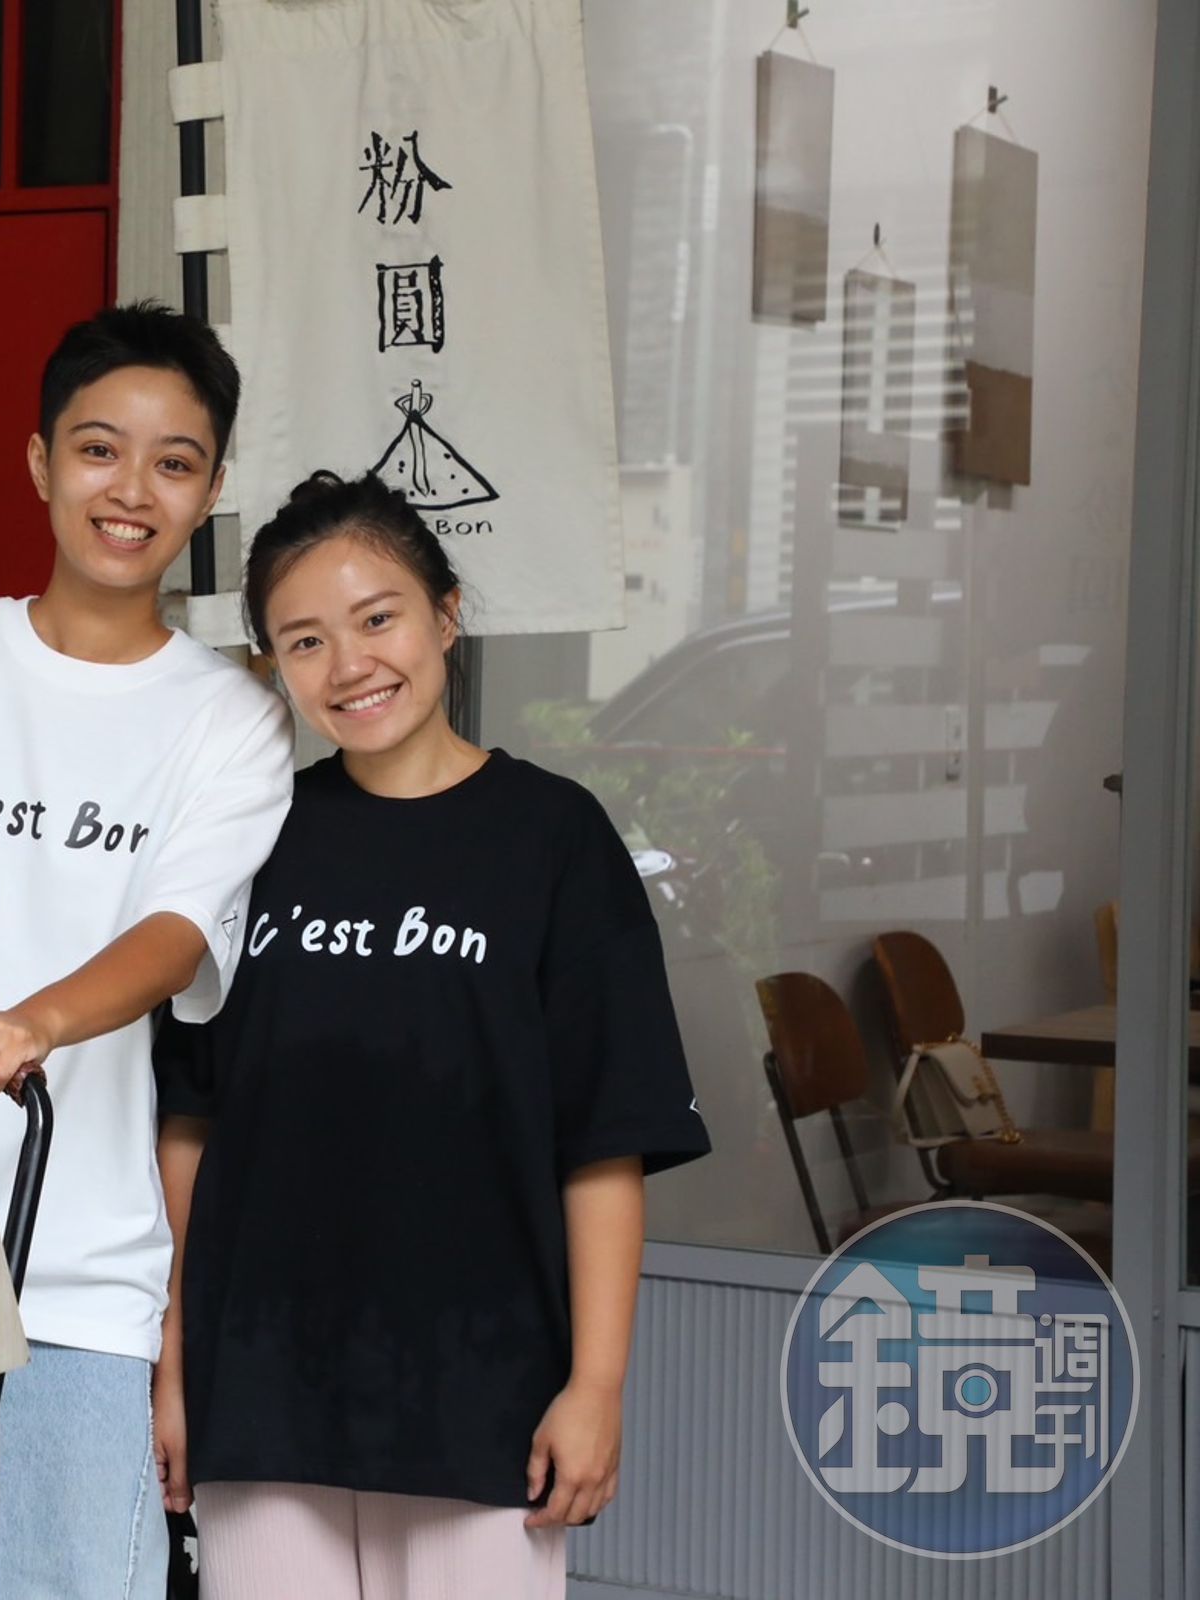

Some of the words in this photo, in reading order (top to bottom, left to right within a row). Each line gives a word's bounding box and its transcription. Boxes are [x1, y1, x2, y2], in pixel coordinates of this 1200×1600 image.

[358, 130, 453, 354] 粉圓
[435, 519, 492, 535] Bon
[248, 905, 375, 957] C'est
[393, 906, 488, 964] Bon
